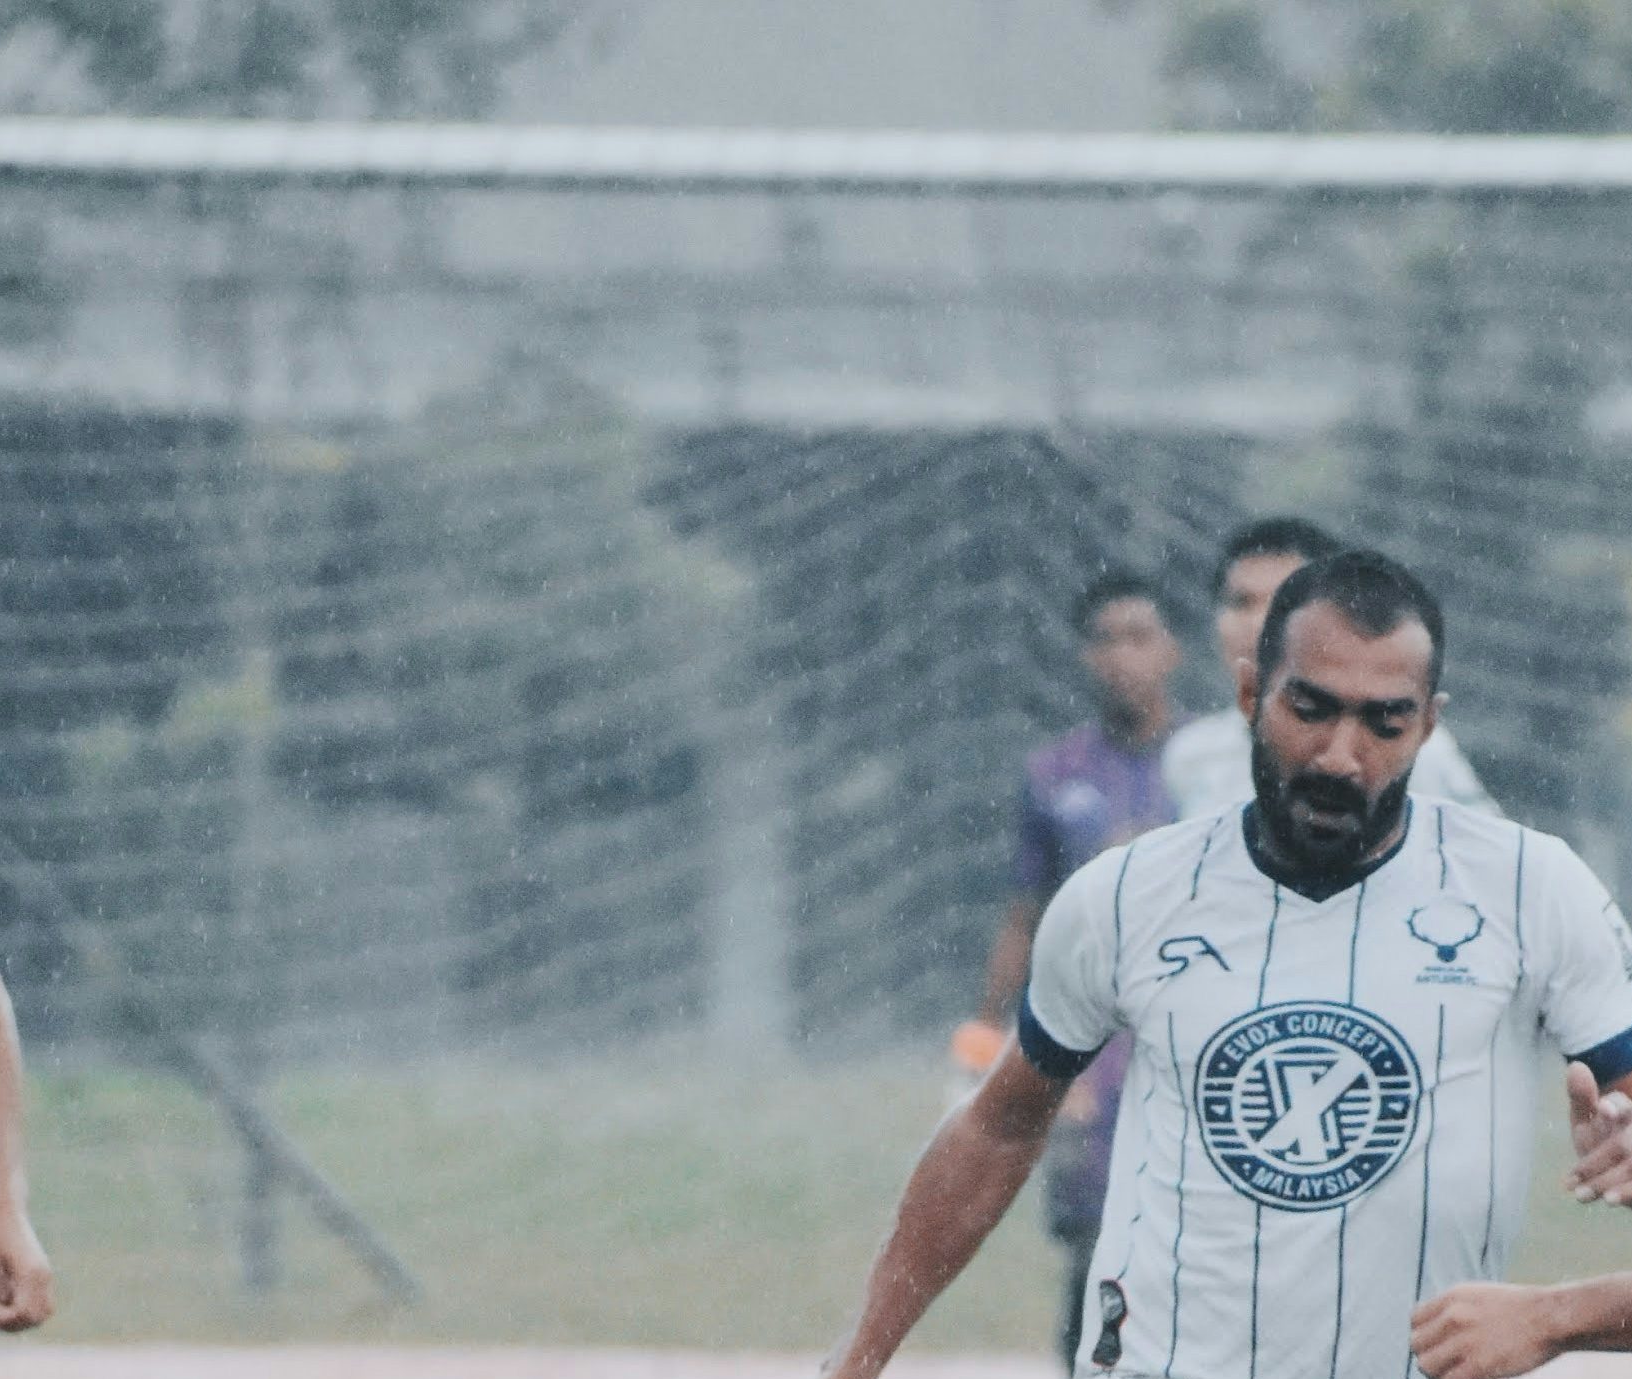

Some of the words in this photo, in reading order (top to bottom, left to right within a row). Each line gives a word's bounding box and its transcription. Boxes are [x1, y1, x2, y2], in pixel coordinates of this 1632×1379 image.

[1223, 1019, 1281, 1062] EVOX
[1286, 1013, 1389, 1058] CONCEPT
[1250, 1166, 1362, 1199] MALAYSIA
